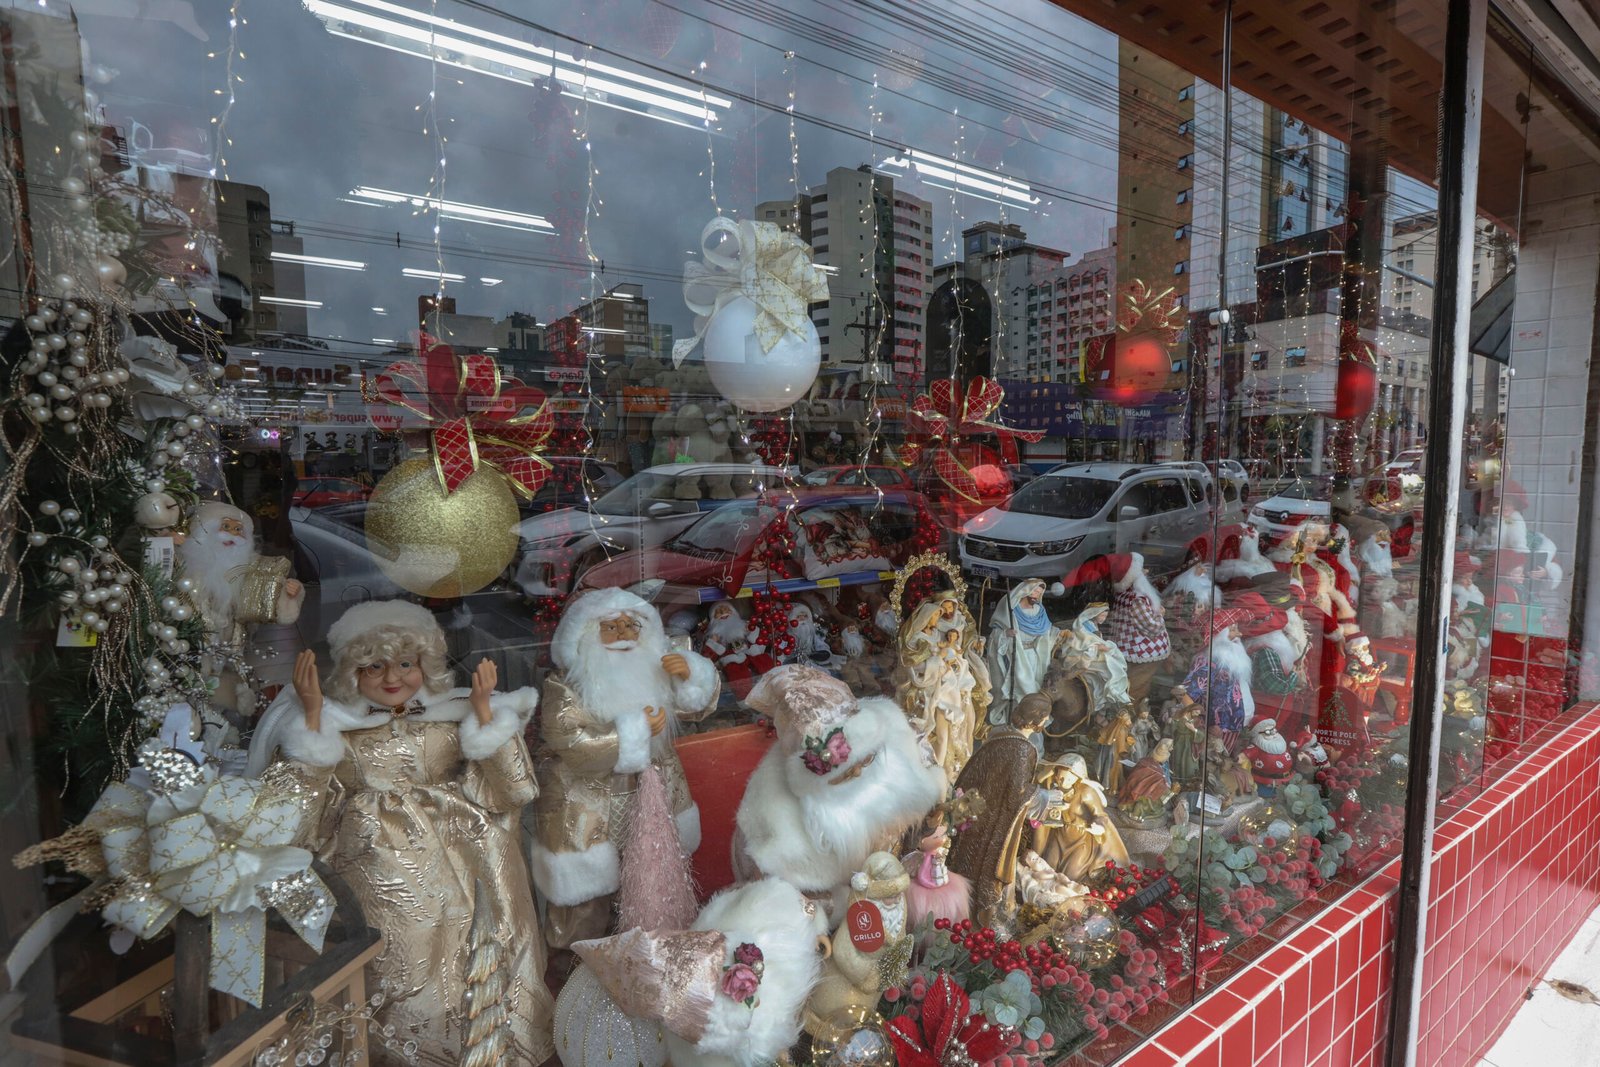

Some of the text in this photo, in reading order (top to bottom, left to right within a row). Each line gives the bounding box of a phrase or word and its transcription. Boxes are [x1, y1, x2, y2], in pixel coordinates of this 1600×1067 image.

[1314, 729, 1358, 740] NORTH POLE
[1320, 736, 1351, 746] EXPRESS
[854, 932, 881, 941] GRILLO
